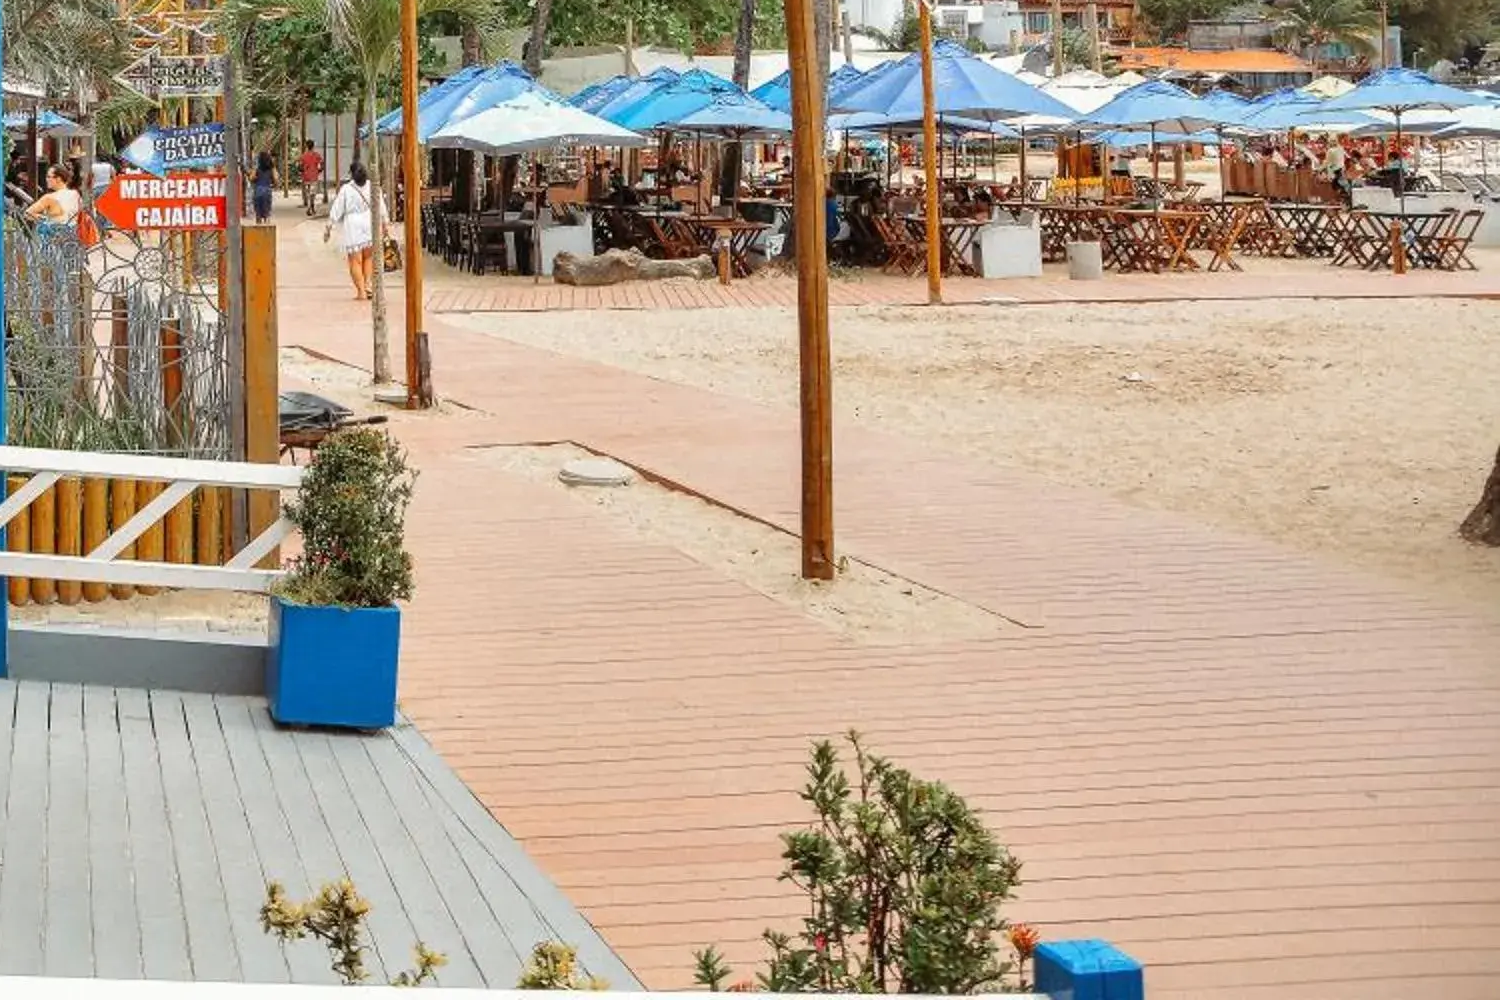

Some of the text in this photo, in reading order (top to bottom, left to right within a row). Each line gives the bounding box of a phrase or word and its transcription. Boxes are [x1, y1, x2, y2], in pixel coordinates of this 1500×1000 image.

[165, 143, 224, 161] DA LUA
[135, 204, 219, 227] CAJAÍBA
